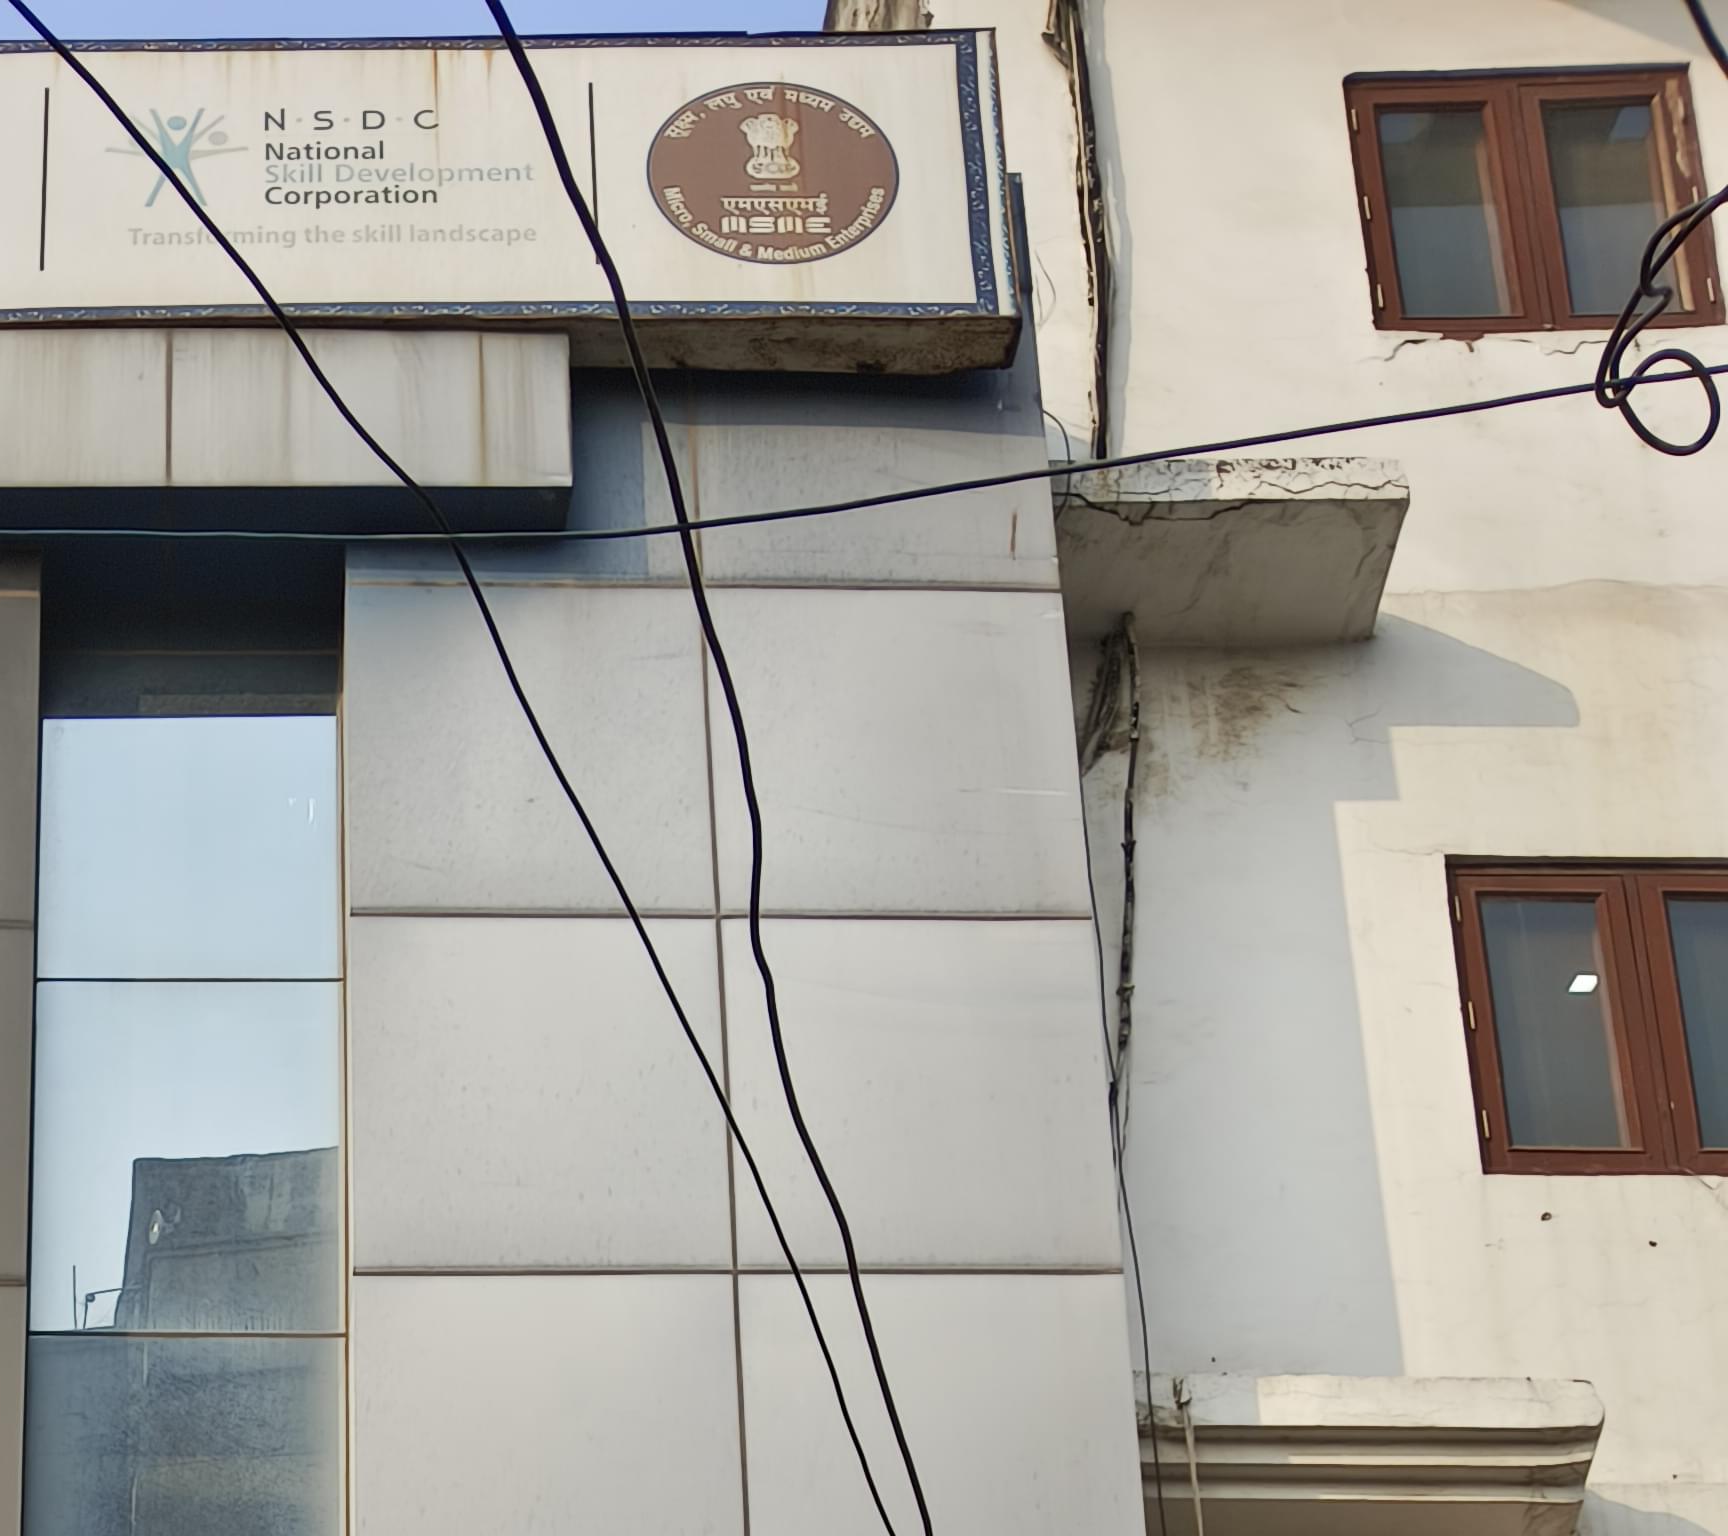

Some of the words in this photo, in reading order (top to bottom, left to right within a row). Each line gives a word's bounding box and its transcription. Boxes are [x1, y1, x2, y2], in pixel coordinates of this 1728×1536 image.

[265, 141, 384, 161] National
[265, 163, 322, 182] Skill
[335, 163, 534, 187] Development
[265, 184, 438, 209] Corporation
[664, 186, 693, 228] Micro,
[691, 222, 738, 253] Small
[739, 243, 753, 257] &
[758, 242, 827, 261] Medium
[824, 187, 885, 248] Enterprises
[128, 226, 296, 248] Transfming
[305, 226, 345, 244] the
[352, 225, 401, 243] skill
[409, 225, 537, 246] landscape
